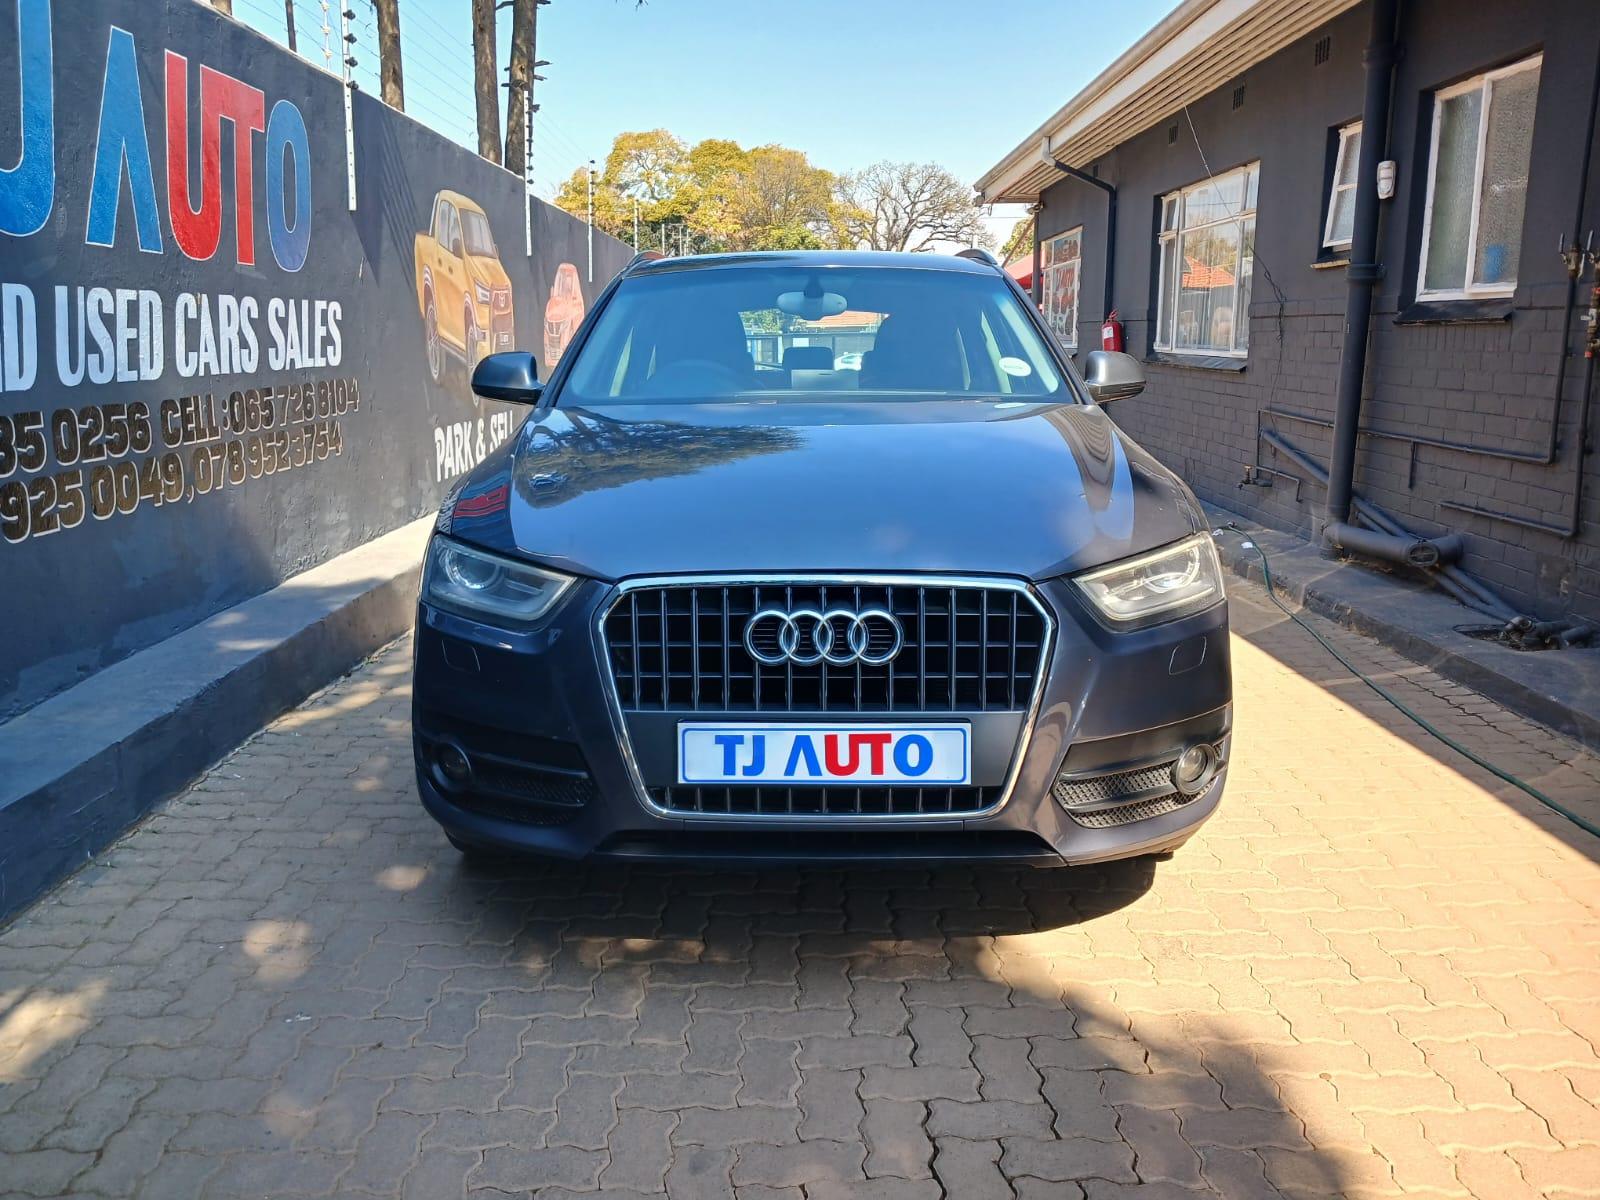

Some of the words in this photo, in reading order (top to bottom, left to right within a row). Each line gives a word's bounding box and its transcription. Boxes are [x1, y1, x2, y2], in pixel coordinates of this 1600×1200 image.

[85, 25, 312, 273] AUTO
[0, 282, 38, 392] D
[55, 285, 164, 387] USED
[175, 293, 259, 378] CARS
[267, 298, 343, 371] SALES
[52, 401, 152, 466] 0256
[434, 421, 475, 483] PARK
[475, 418, 487, 464] &
[714, 734, 766, 776] TJ
[783, 733, 934, 777] AUTO
